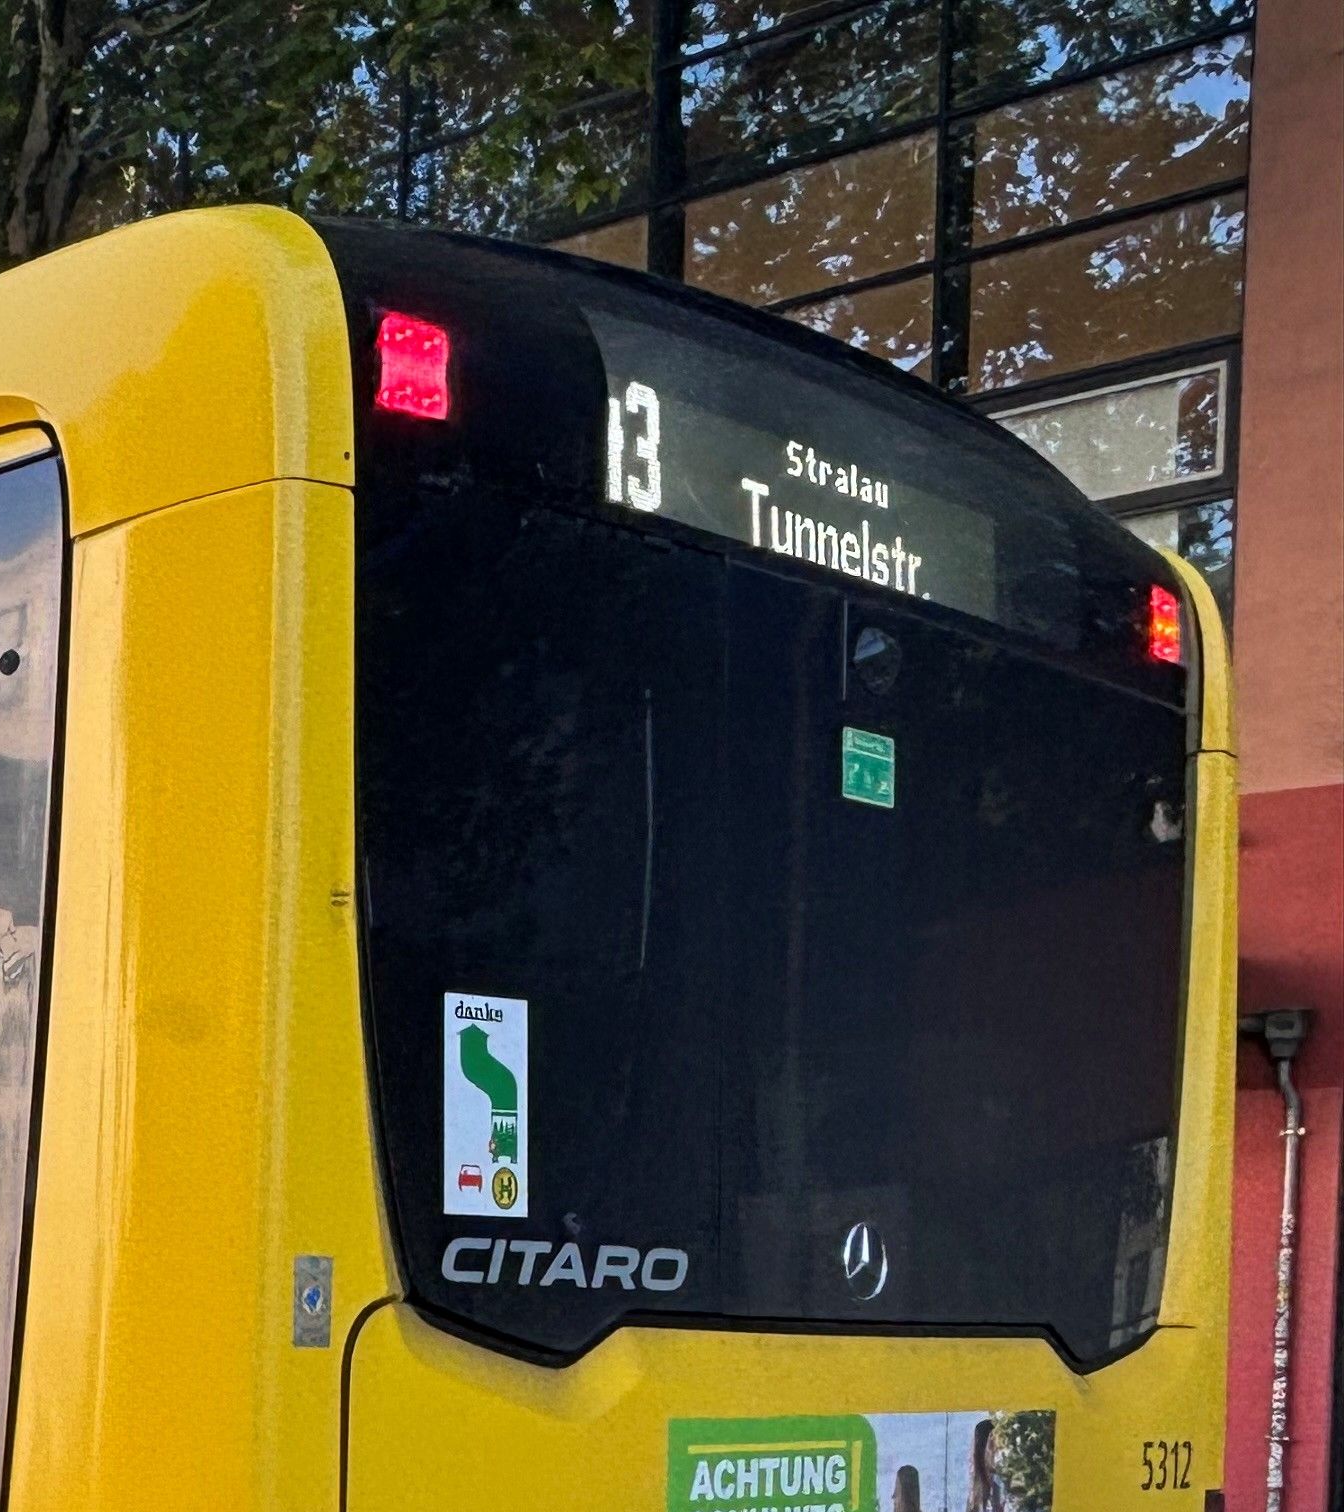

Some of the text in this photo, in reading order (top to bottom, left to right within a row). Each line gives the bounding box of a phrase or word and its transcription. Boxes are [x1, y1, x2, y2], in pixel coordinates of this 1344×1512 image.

[785, 440, 890, 509] Stralau
[740, 477, 931, 601] Tunnelstr.
[441, 1237, 689, 1291] CITARO
[689, 1454, 847, 1501] ACHTUNG
[1140, 1440, 1192, 1491] 5312
